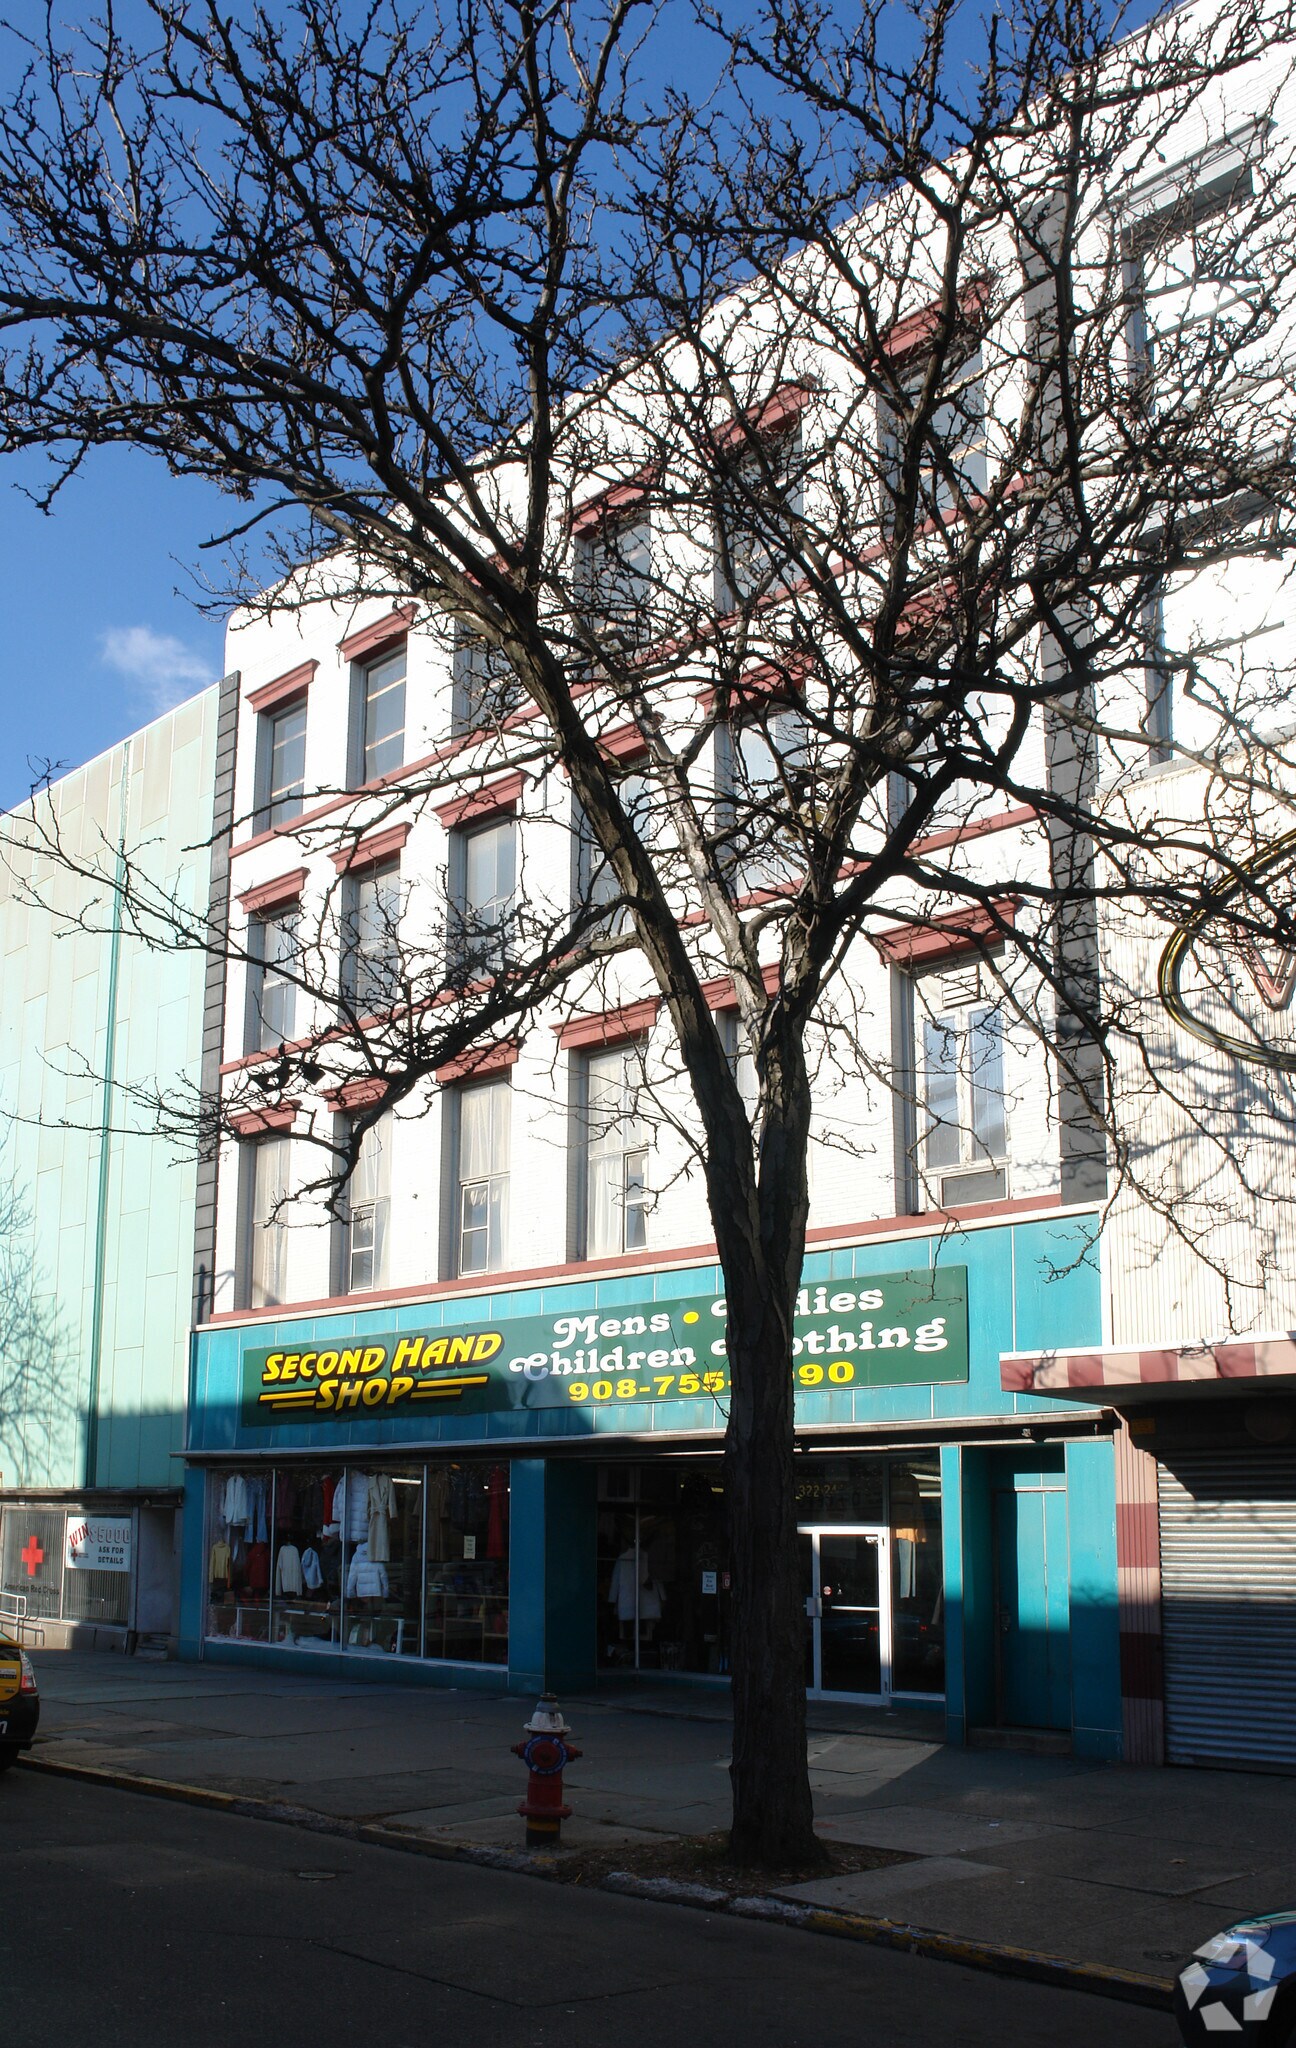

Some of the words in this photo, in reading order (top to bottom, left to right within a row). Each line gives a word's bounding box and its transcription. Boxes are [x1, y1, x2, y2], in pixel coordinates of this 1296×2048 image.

[552, 1312, 670, 1348] Mens
[262, 1347, 386, 1381] SECOND
[391, 1333, 502, 1373] HAND
[508, 1345, 697, 1381] Children
[710, 1317, 948, 1356] othing
[315, 1376, 414, 1411] SHOP
[69, 1522, 89, 1548] WIN
[99, 1546, 110, 1554] ASK
[98, 1556, 124, 1564] DETAILS
